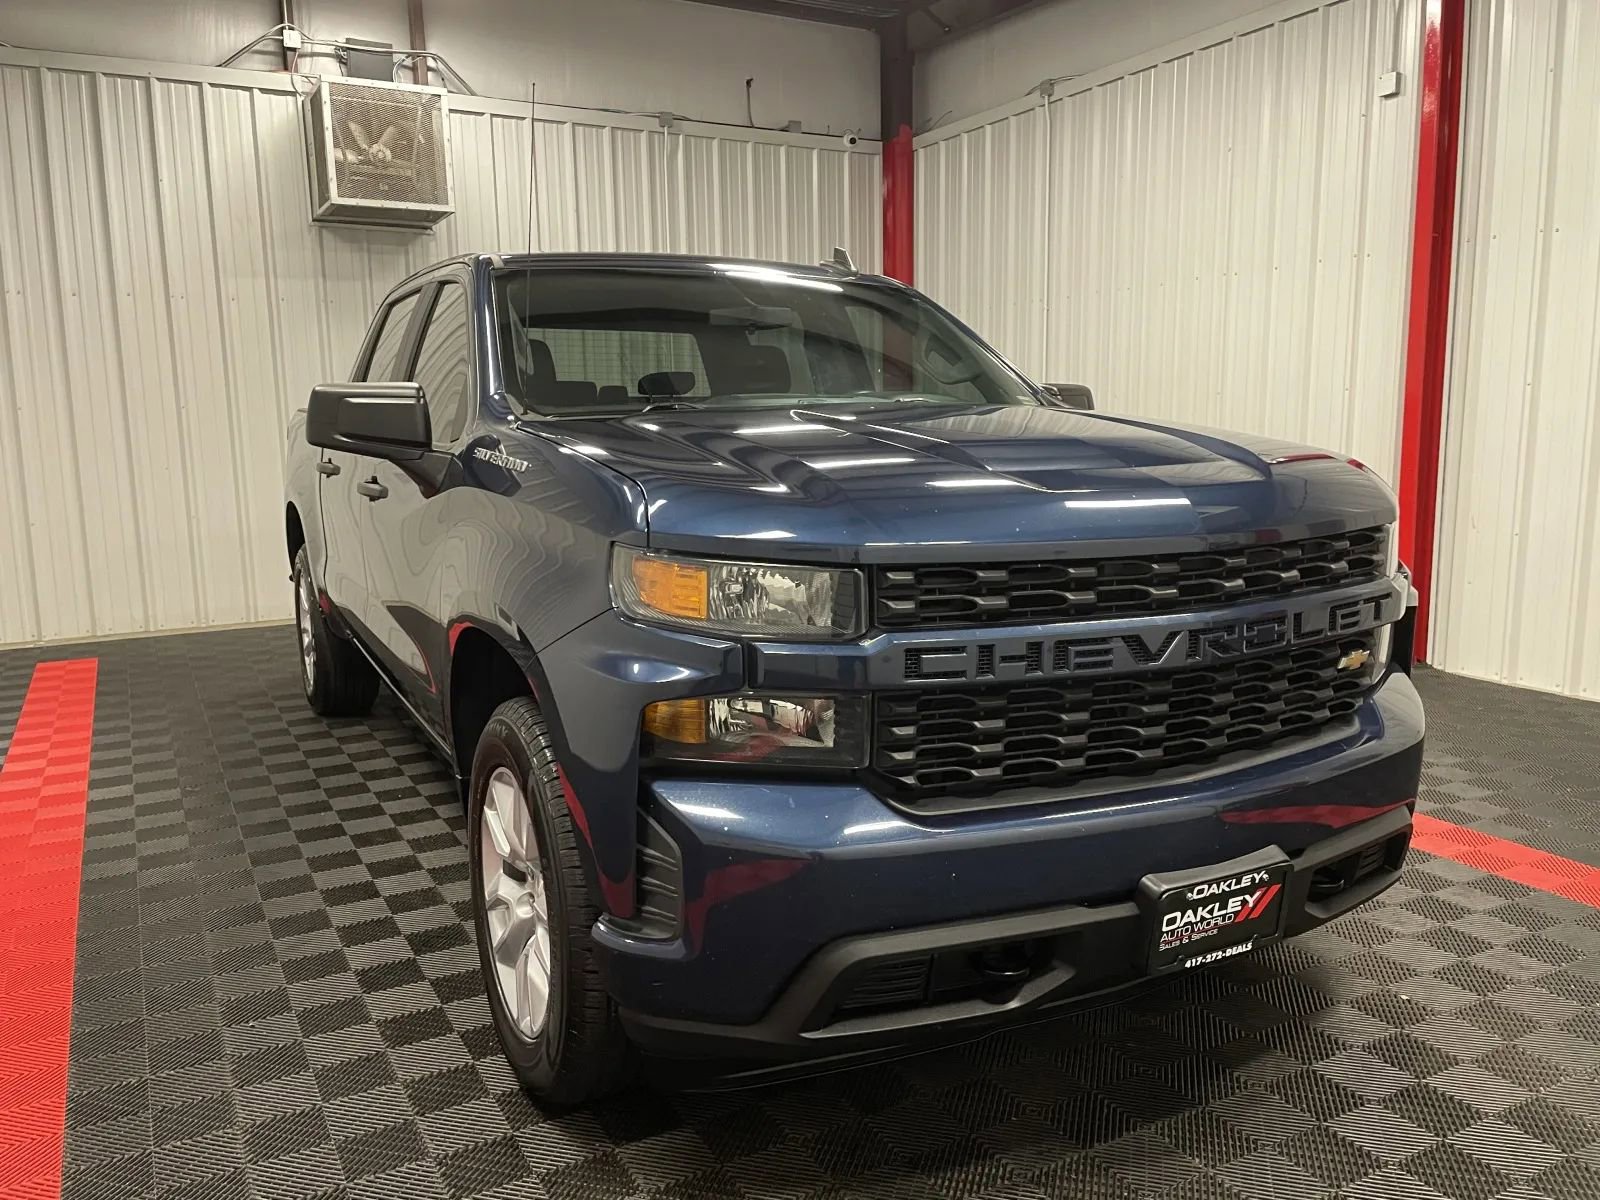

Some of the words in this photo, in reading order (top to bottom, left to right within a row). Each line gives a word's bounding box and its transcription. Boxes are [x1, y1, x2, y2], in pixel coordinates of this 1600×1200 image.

[903, 593, 1392, 682] CHEVROLET
[1193, 870, 1267, 899] OAKLEY
[1162, 890, 1263, 932] OAKLEY
[1160, 926, 1192, 943] AUTO
[1193, 913, 1235, 932] WORLD
[1182, 936, 1189, 944] &
[1184, 941, 1253, 968] 417-272-DEALS
